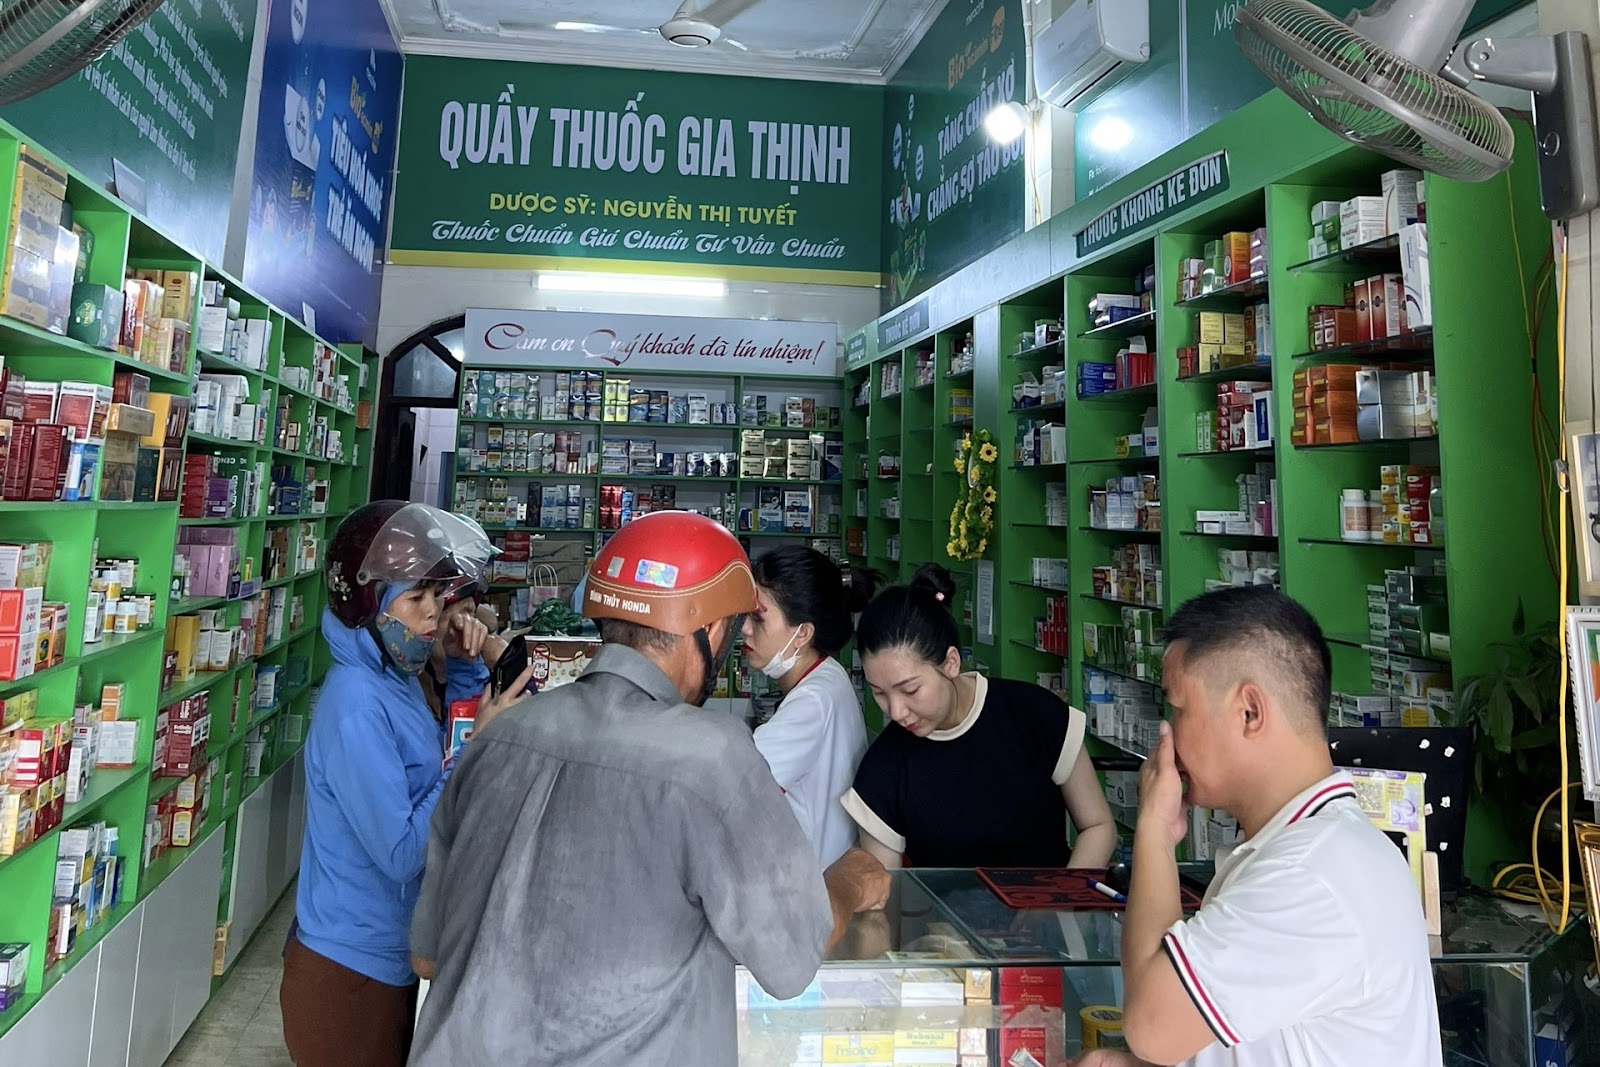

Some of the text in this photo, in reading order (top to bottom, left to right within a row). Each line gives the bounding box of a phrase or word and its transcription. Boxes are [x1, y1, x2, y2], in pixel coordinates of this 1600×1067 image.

[938, 111, 964, 160] TĂNG
[966, 66, 995, 136] CHẤT
[439, 83, 851, 195] QUẦY THUỐC GIA THỊNH
[960, 153, 975, 203] SỢ
[490, 193, 798, 228] DƯỢC SỸ: NGUYỄN THỊ TUYẾT
[432, 219, 500, 242] Thuốc
[505, 223, 573, 245] Chuẩn
[579, 226, 618, 247] Giá
[624, 229, 690, 251] Chuẩn
[731, 232, 775, 255] Vấn
[781, 237, 846, 259] Chuẩn
[639, 333, 696, 355] khách
[699, 336, 729, 357] đã
[733, 338, 758, 357] tín
[603, 593, 620, 608] THỦY
[622, 599, 651, 615] HONDA
